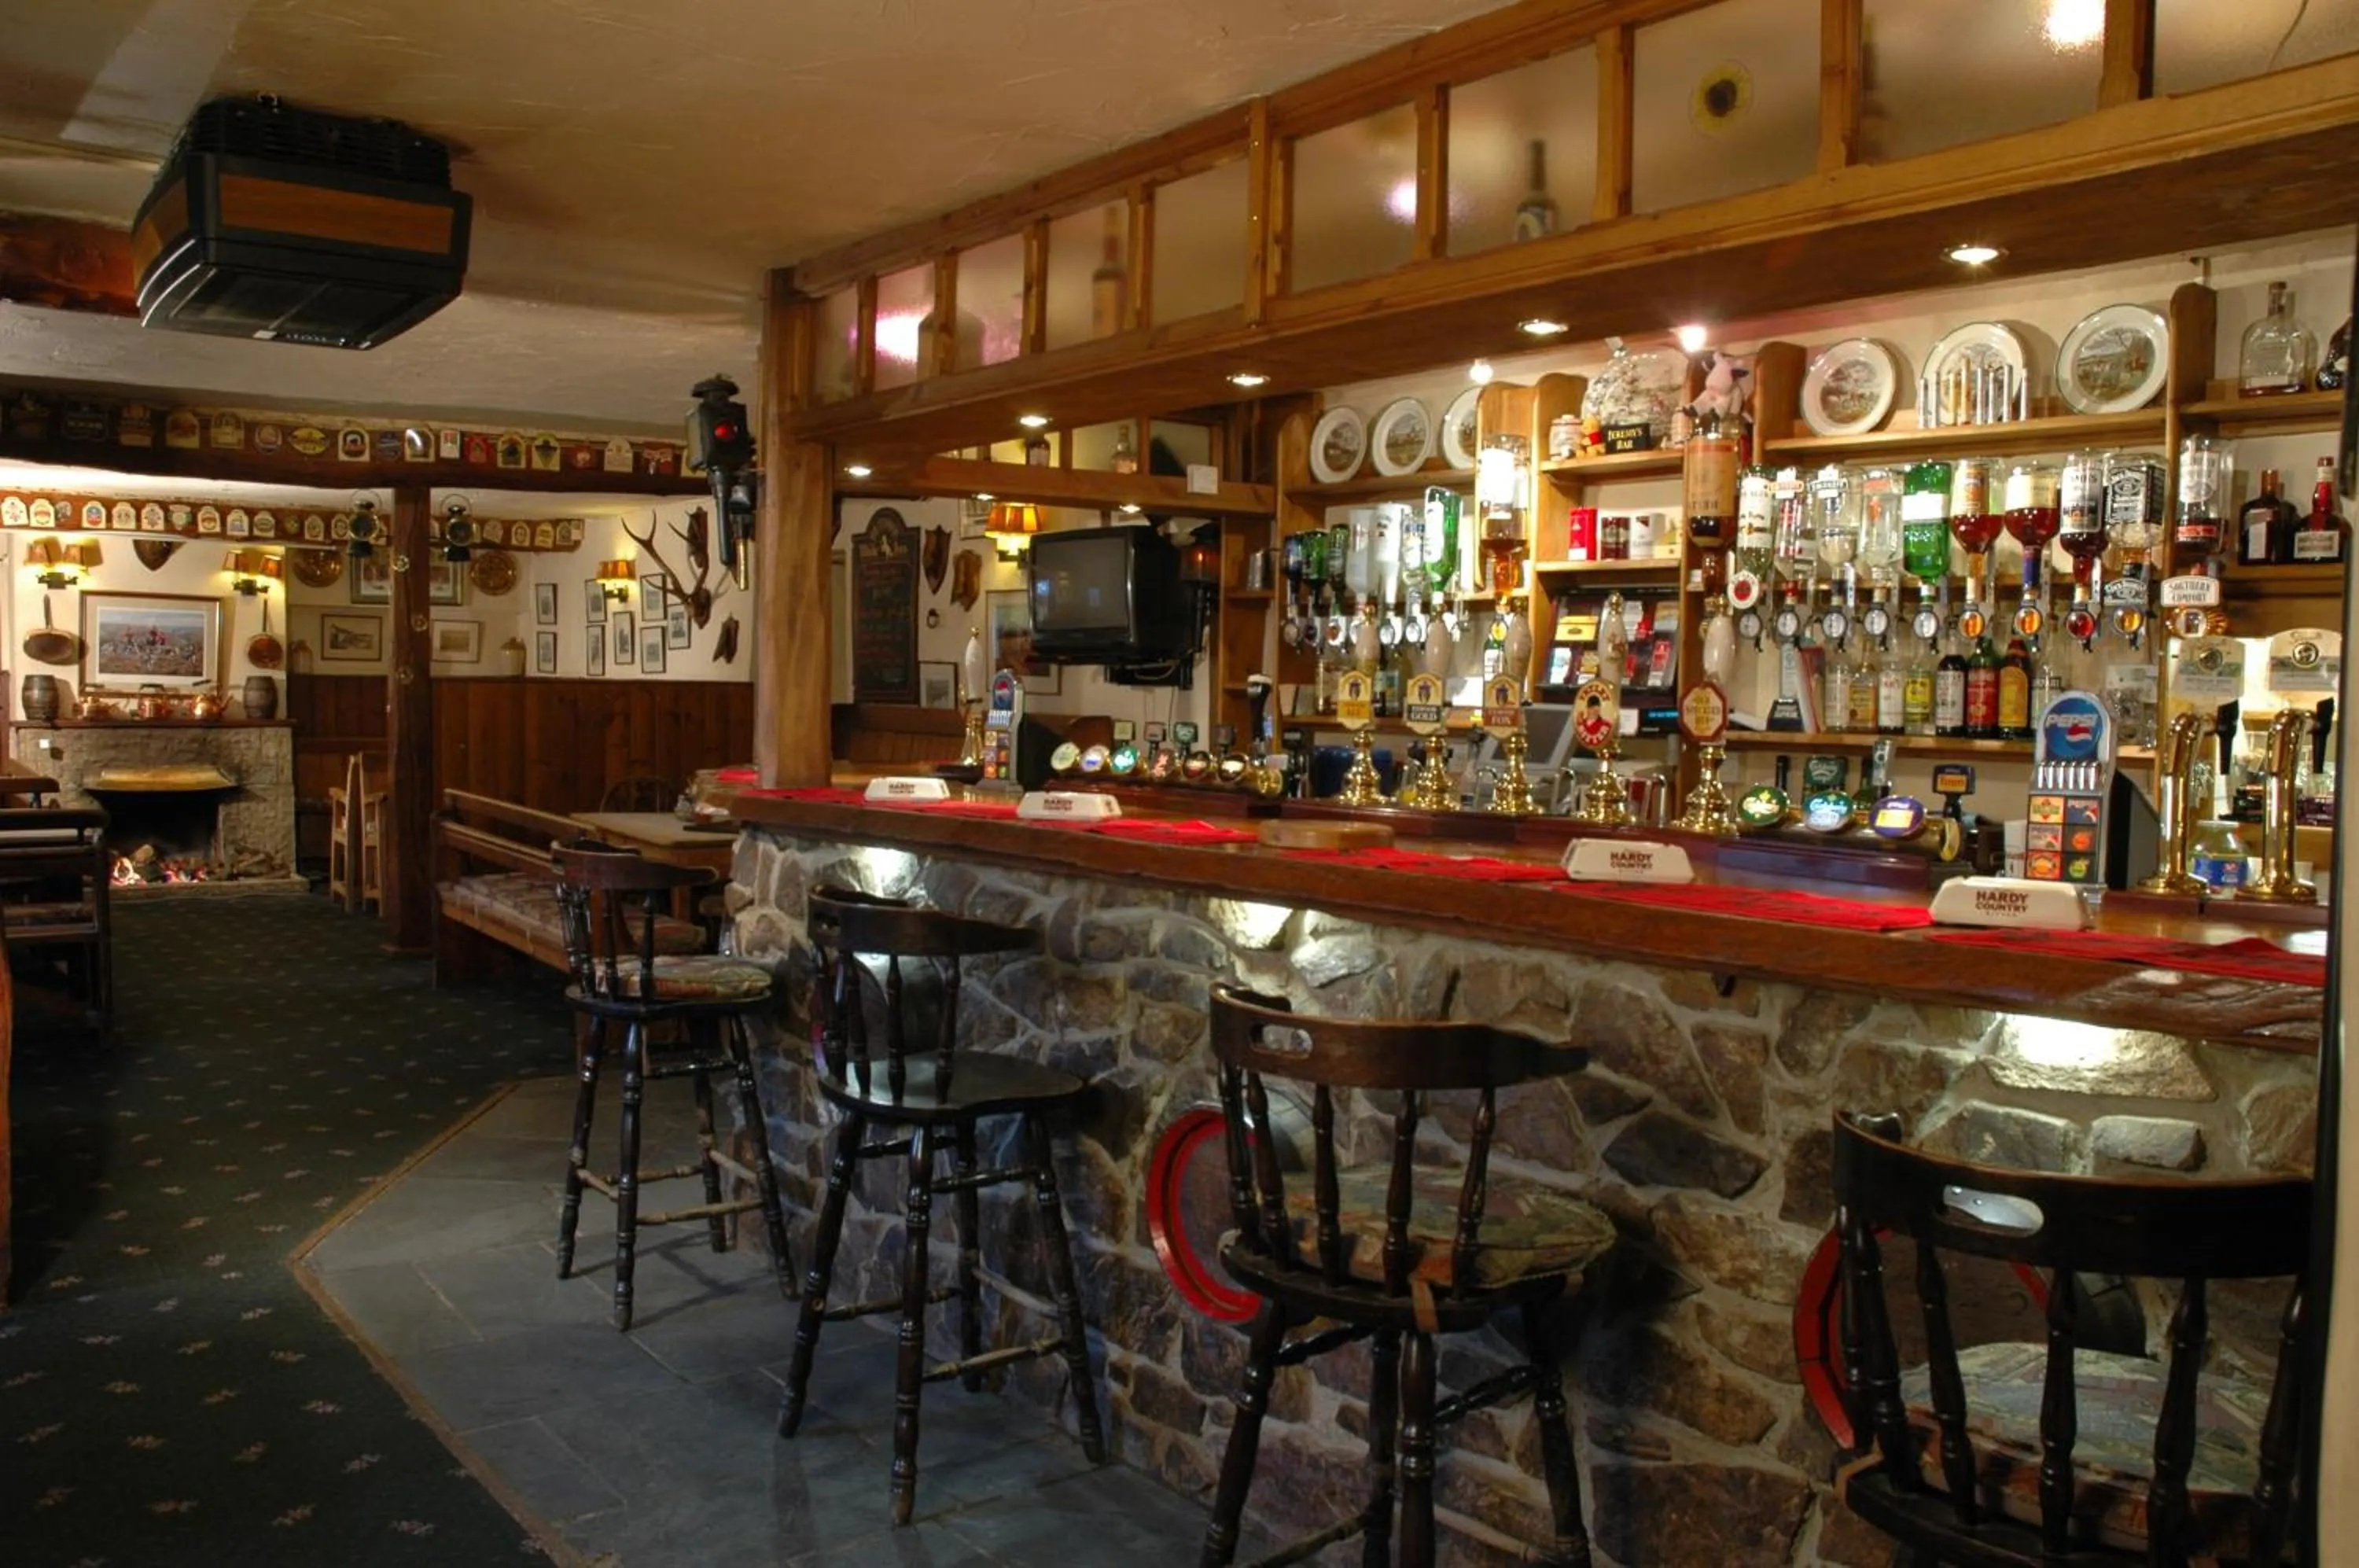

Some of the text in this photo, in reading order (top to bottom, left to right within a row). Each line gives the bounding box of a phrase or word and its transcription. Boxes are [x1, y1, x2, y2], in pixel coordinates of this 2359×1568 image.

[1617, 440, 1633, 450] BAR
[2169, 580, 2210, 591] SOUTHERN
[2172, 592, 2206, 602] COMFORT
[2046, 713, 2098, 728] PEPSI
[1610, 852, 1654, 863] HARDY
[1976, 890, 2029, 904] HARDY
[1974, 902, 2028, 913] COUNTRY
